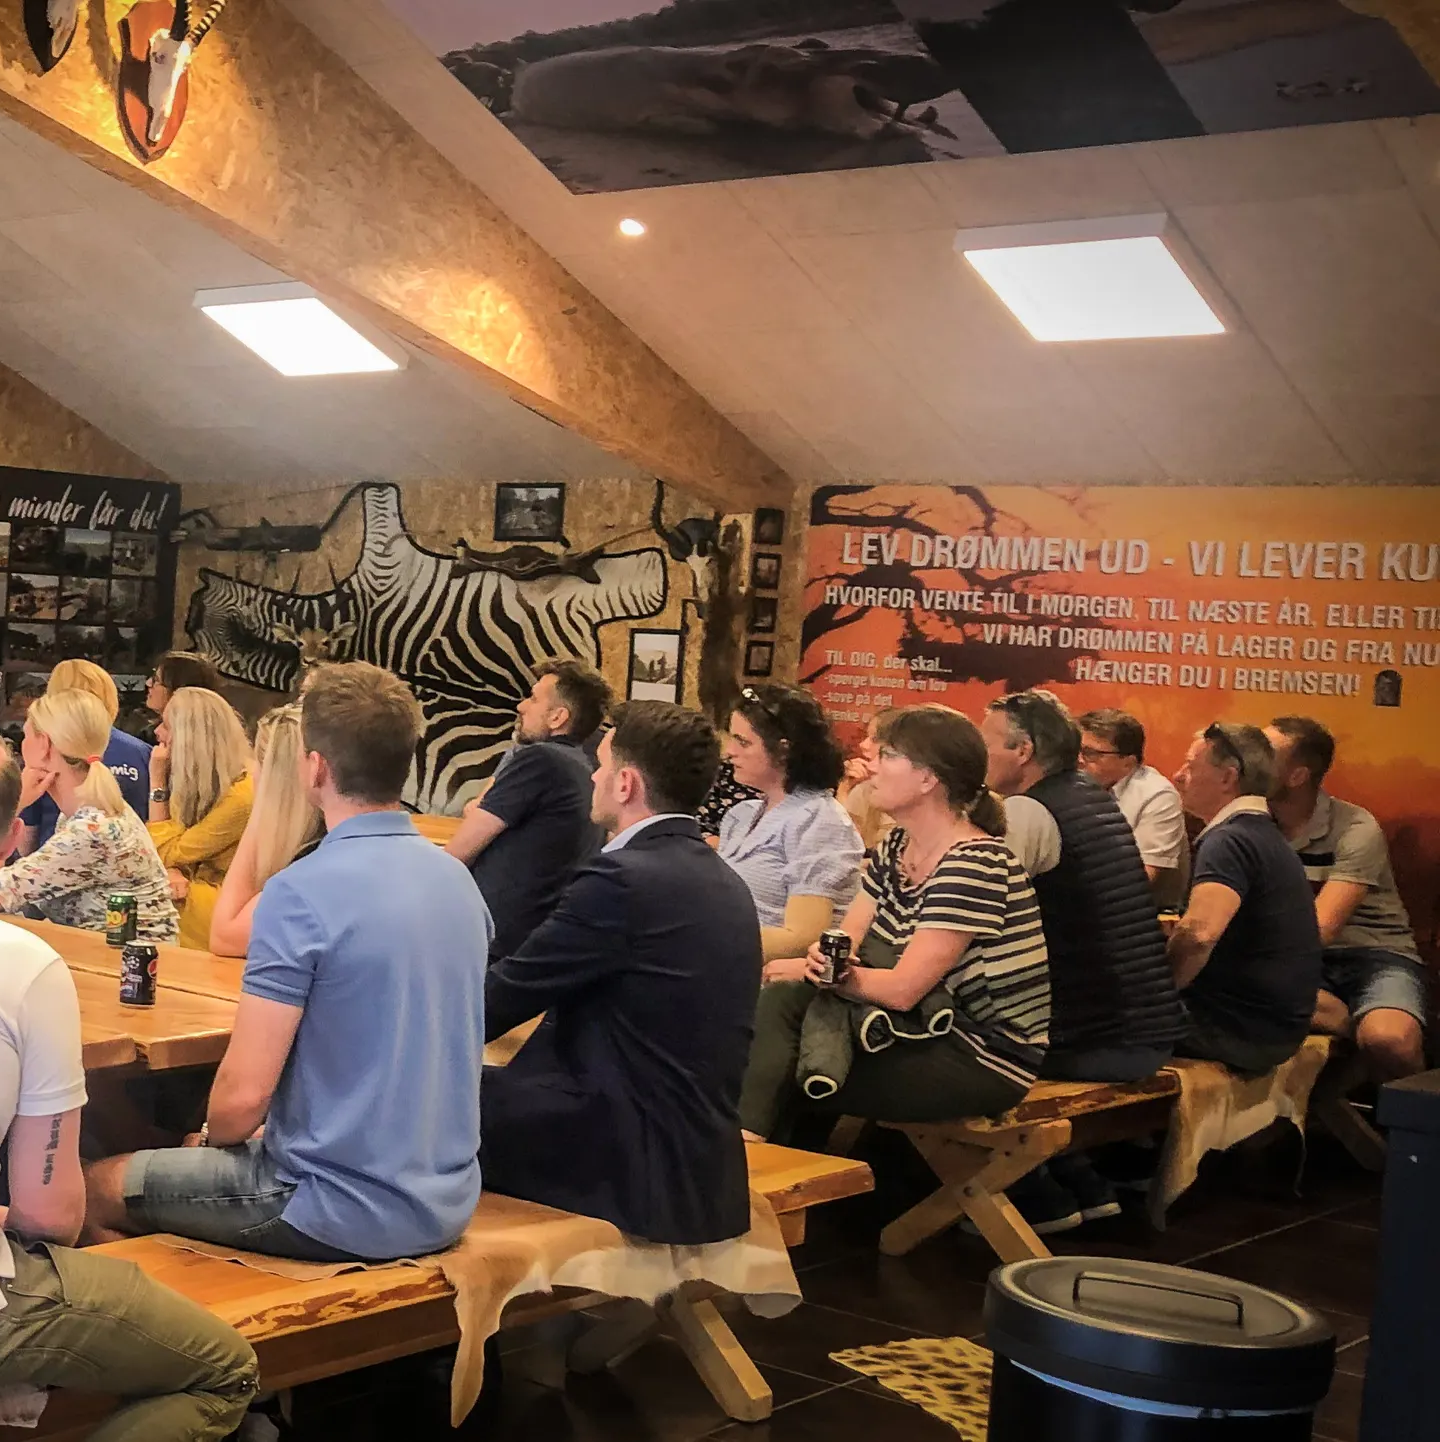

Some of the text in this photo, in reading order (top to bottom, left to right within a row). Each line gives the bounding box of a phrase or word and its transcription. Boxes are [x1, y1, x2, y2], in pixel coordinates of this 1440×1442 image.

[9, 485, 86, 525] minder
[842, 532, 900, 566] LEV
[910, 533, 1085, 573] DRØMMEN
[1099, 538, 1150, 574] UD
[1189, 540, 1225, 577] VI
[1238, 541, 1366, 580] LEVER
[824, 585, 915, 608] HVORFOR
[921, 589, 985, 612] VENTE
[990, 592, 1021, 614] TIL
[1026, 594, 1034, 614] I
[1040, 595, 1139, 621] MORGEN,
[1147, 598, 1180, 621] TIL
[1188, 600, 1271, 624] NÆSTE
[1326, 604, 1405, 628] ELLER
[825, 650, 847, 665] TIL
[883, 654, 907, 669] der
[983, 624, 1002, 644] VI
[1009, 626, 1052, 647] HAR
[1058, 627, 1173, 655] DRØMMEN
[1181, 629, 1209, 655] PÅ
[1216, 634, 1294, 660] LAGER
[1301, 637, 1337, 661] OG
[1344, 639, 1395, 664] FRA
[1075, 658, 1360, 697] HÆNGER DU I BREMSEN!
[856, 693, 871, 706] på
[874, 694, 892, 706] det
